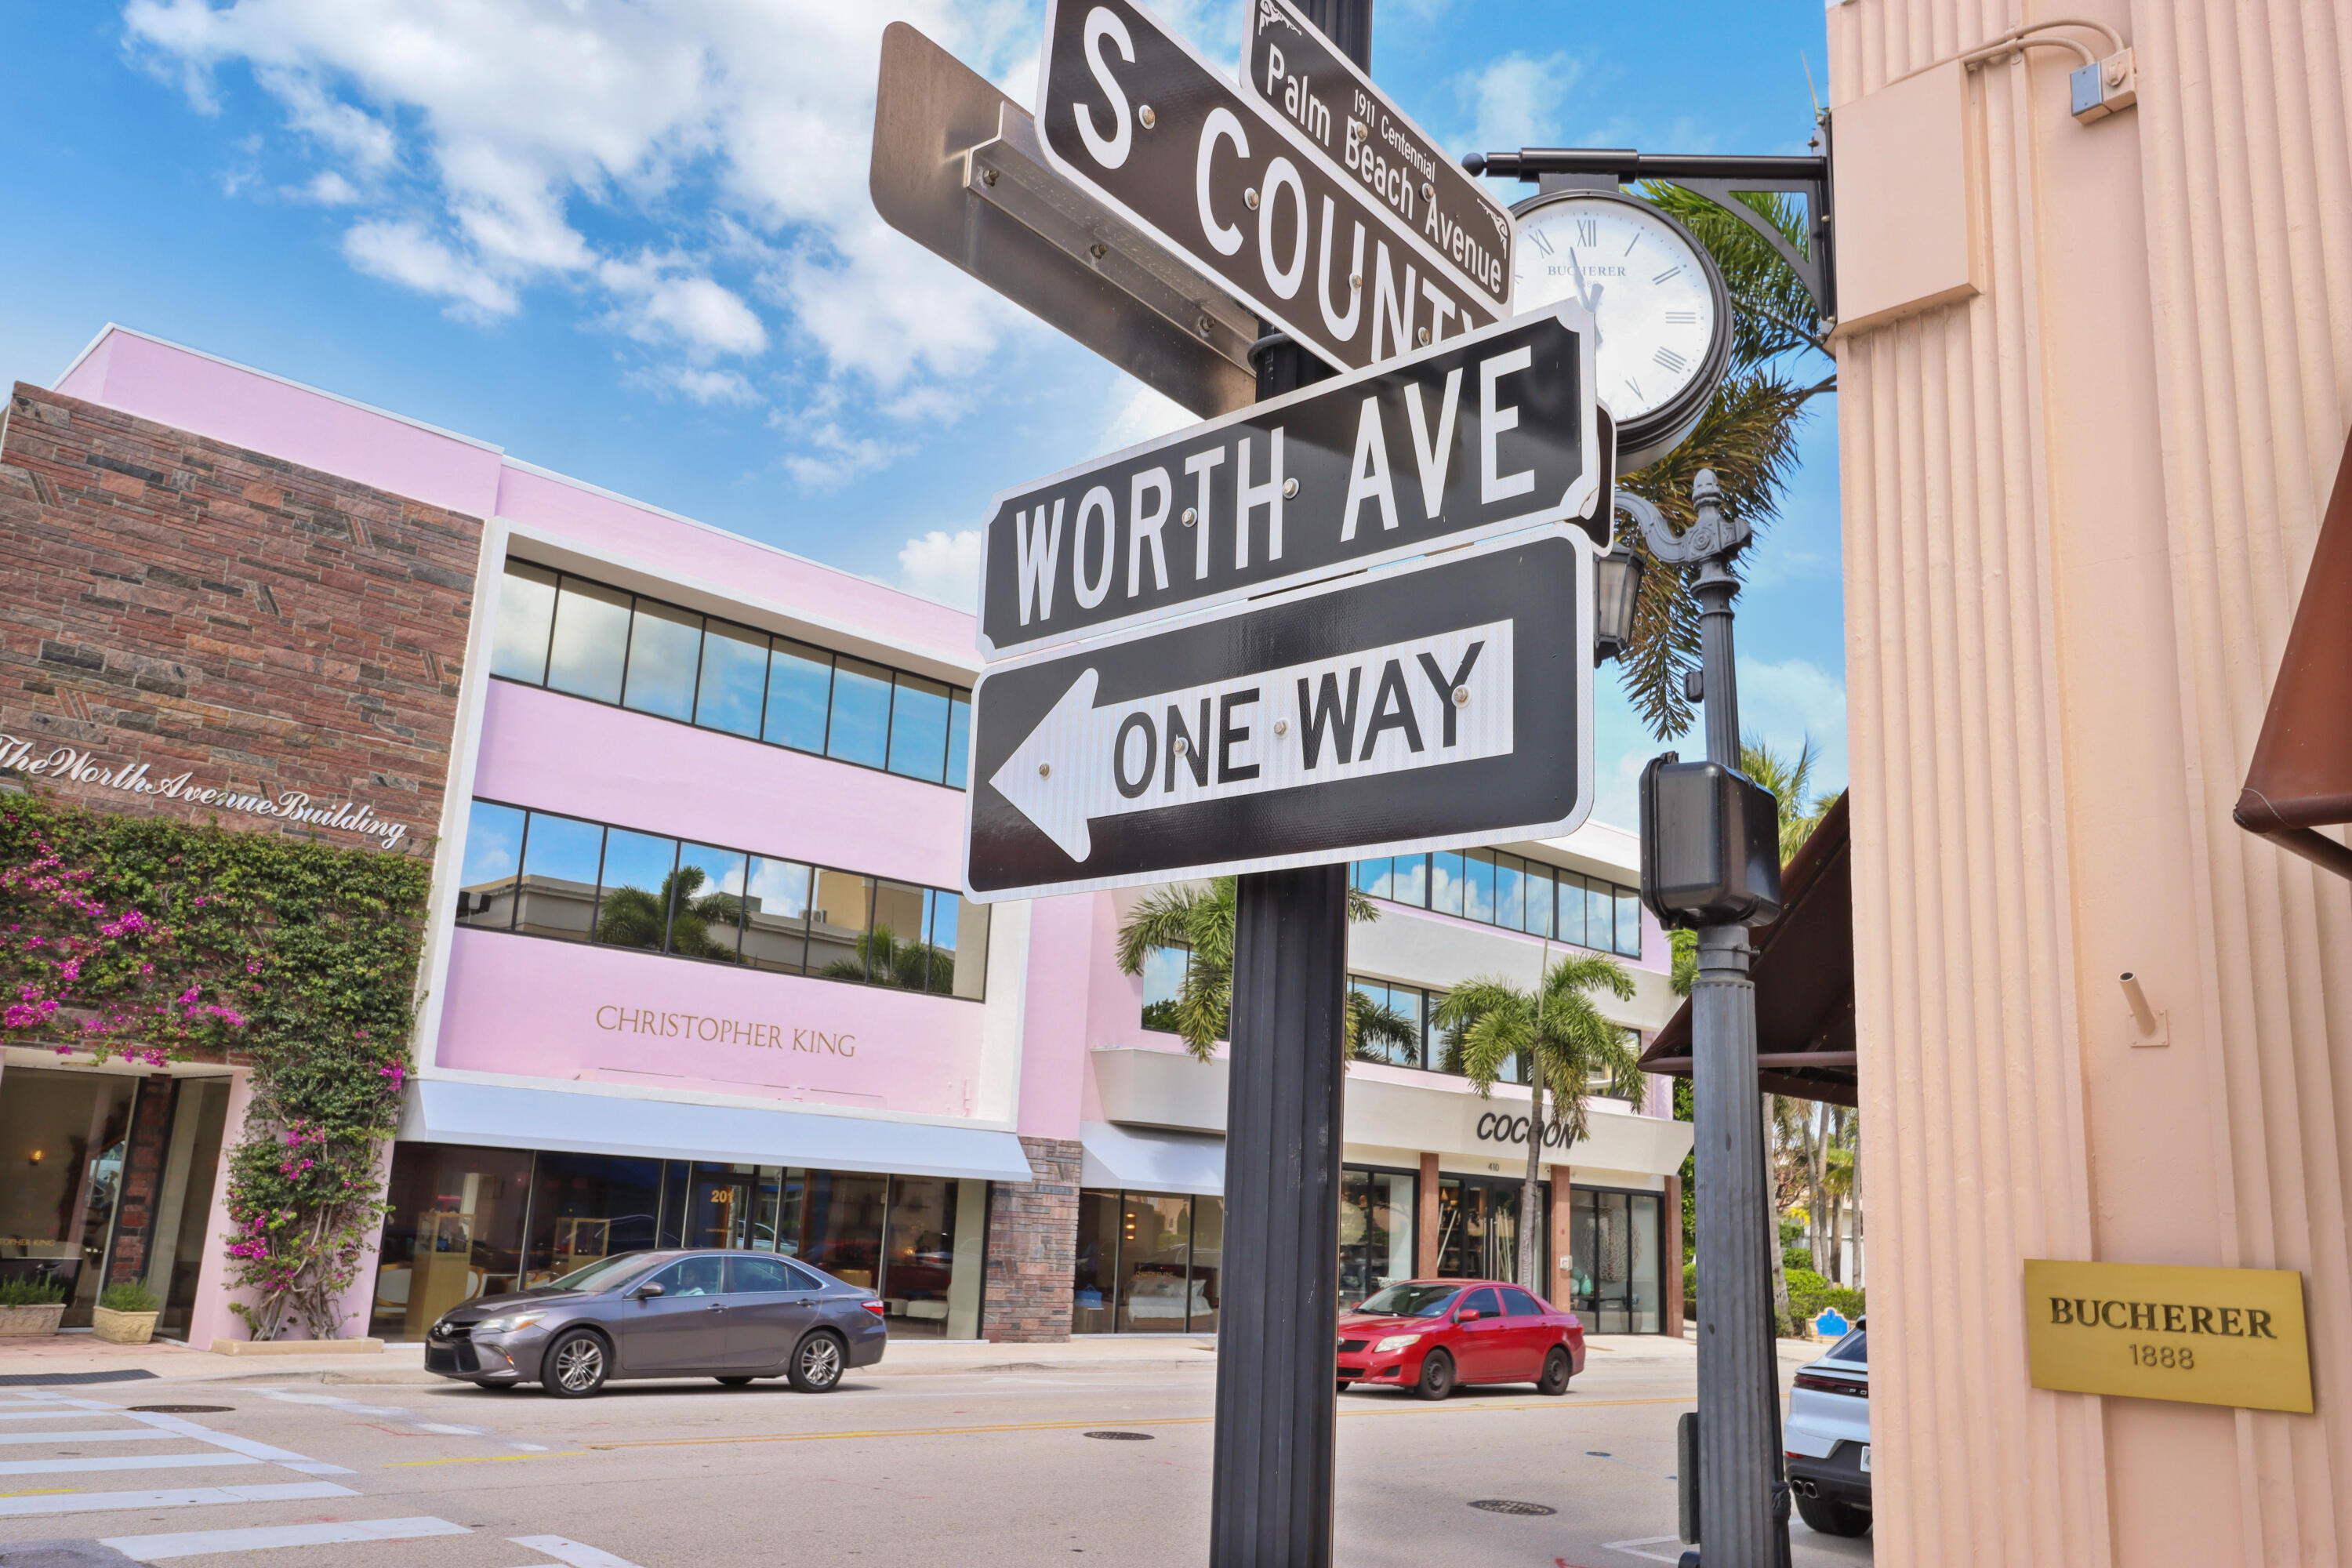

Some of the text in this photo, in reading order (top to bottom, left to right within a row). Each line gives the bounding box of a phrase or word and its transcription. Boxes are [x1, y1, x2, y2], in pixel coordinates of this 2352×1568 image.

[1267, 43, 1501, 293] Palm Beach Avenue
[1354, 89, 1436, 183] 1911 Centennial
[1196, 107, 1474, 363] COUNT
[1548, 265, 1627, 277] BUCHERER
[1016, 346, 1535, 626] WORTH AVE
[1112, 641, 1486, 799] ONE WAY
[0, 734, 408, 849] The Worth Avenue Building
[596, 1005, 856, 1058] CHRISTOPHER KING
[711, 1189, 733, 1203] 201
[1488, 1163, 1499, 1172] 410
[2049, 1297, 2278, 1339] BUCHERER
[2129, 1344, 2194, 1370] 1888
